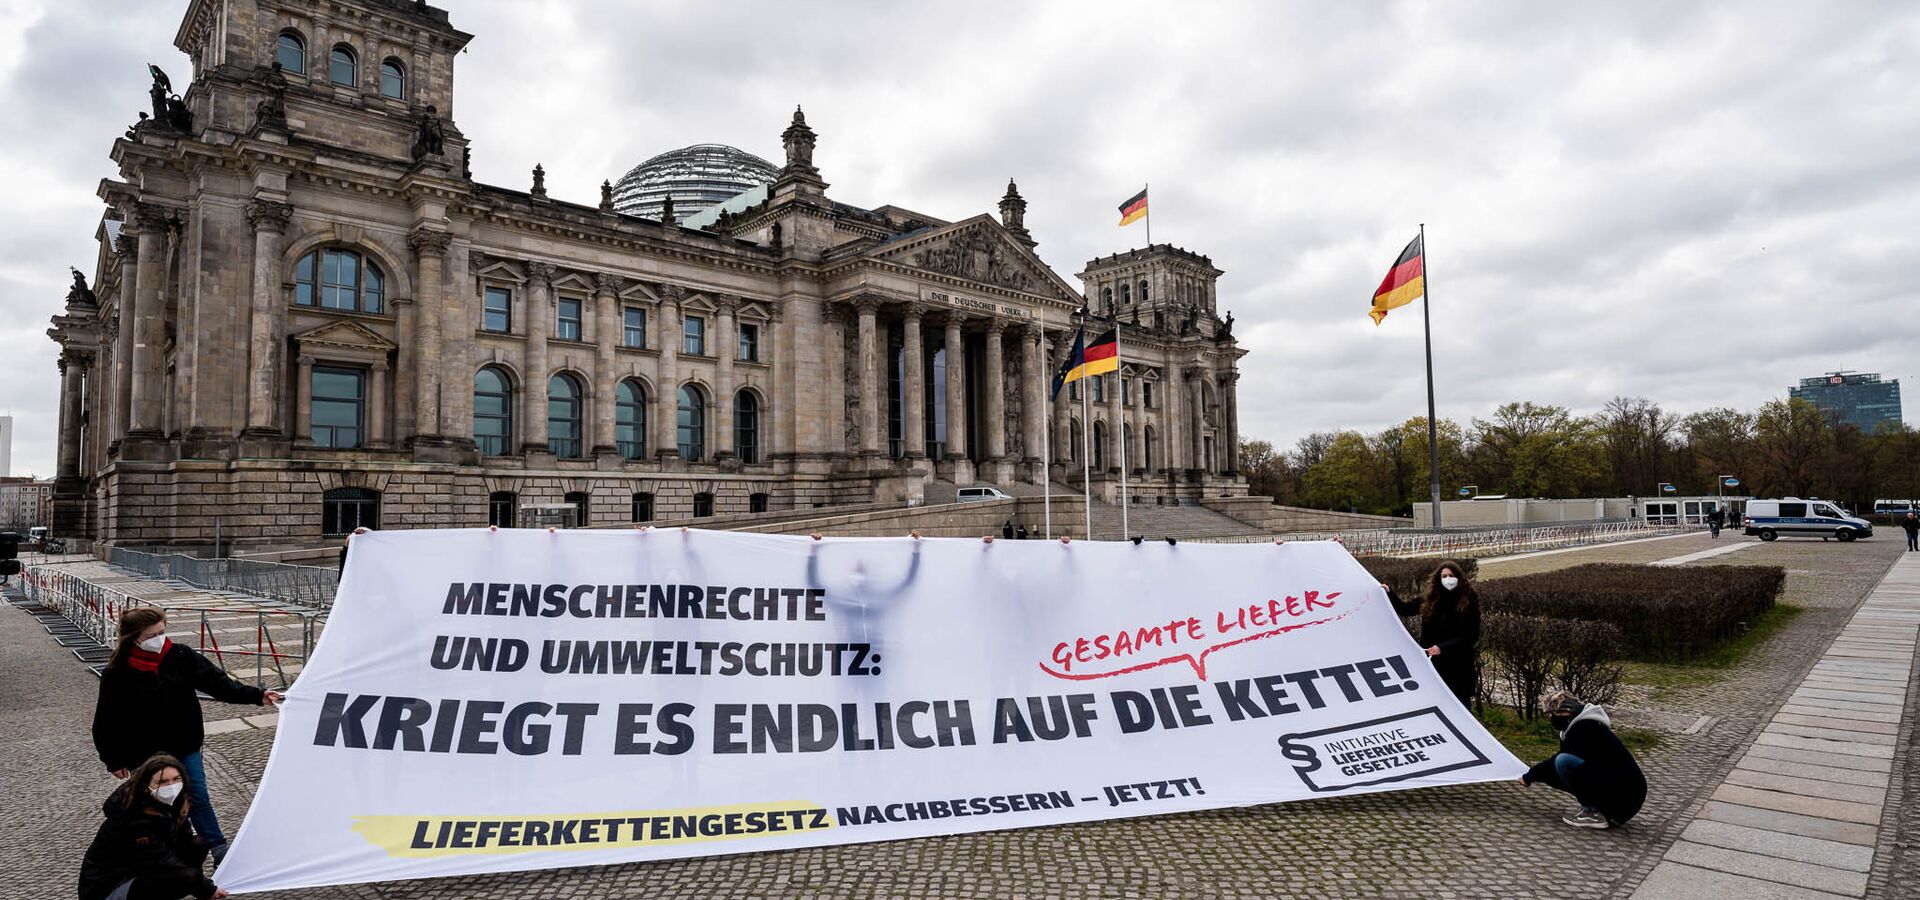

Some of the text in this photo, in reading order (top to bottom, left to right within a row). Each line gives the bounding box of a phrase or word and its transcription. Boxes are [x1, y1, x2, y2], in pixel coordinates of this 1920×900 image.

[931, 292, 949, 302] DEM
[442, 582, 826, 621] MENSCHENRECHTE
[1052, 590, 1343, 671] GESAMTE LIEFER-
[430, 635, 882, 677] UND UMWELTSCHUTZ:
[313, 654, 1420, 756] KRIEGT ES ENDLICH AUF DIE KETTE!
[1324, 728, 1410, 754] INITIATIVE
[1331, 733, 1448, 766] LIEFERKETTEN
[1341, 752, 1431, 777] GESETZ.DE
[410, 808, 830, 849] LIEFERKETTENGESETZ
[837, 791, 1075, 827] NACHBESSERN
[1103, 777, 1206, 808] JETZT!
